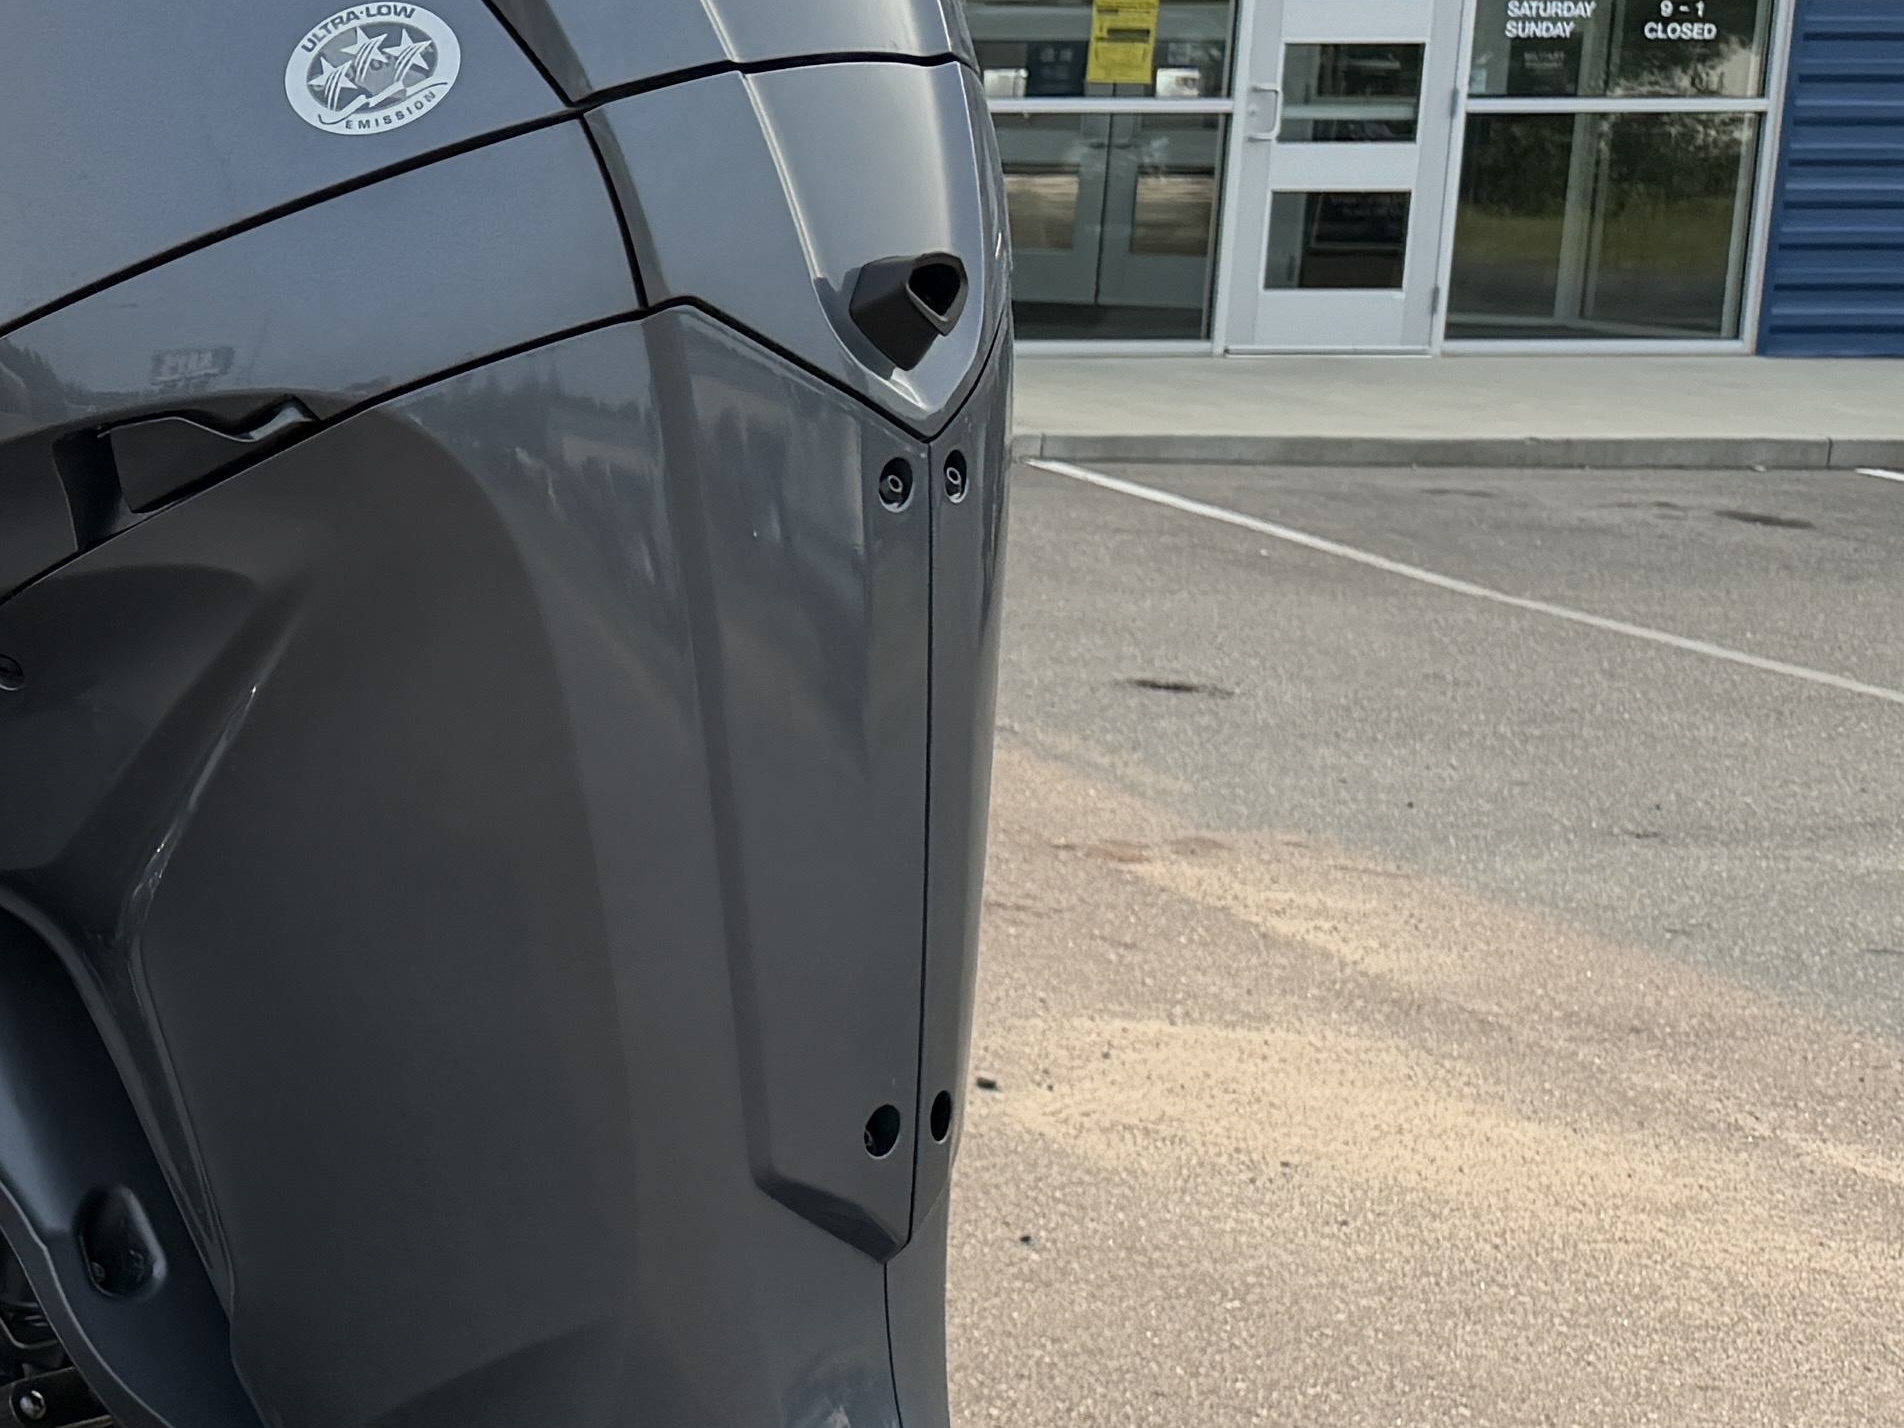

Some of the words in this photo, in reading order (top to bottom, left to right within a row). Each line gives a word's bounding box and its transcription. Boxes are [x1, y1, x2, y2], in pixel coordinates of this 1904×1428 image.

[1507, 0, 1596, 18] SATURDAY
[1660, 0, 1673, 17] 9
[1695, 0, 1705, 17] 1
[1505, 21, 1575, 38] SUNDAY
[1644, 22, 1717, 40] CLOSED
[345, 91, 437, 130] EMISSION
